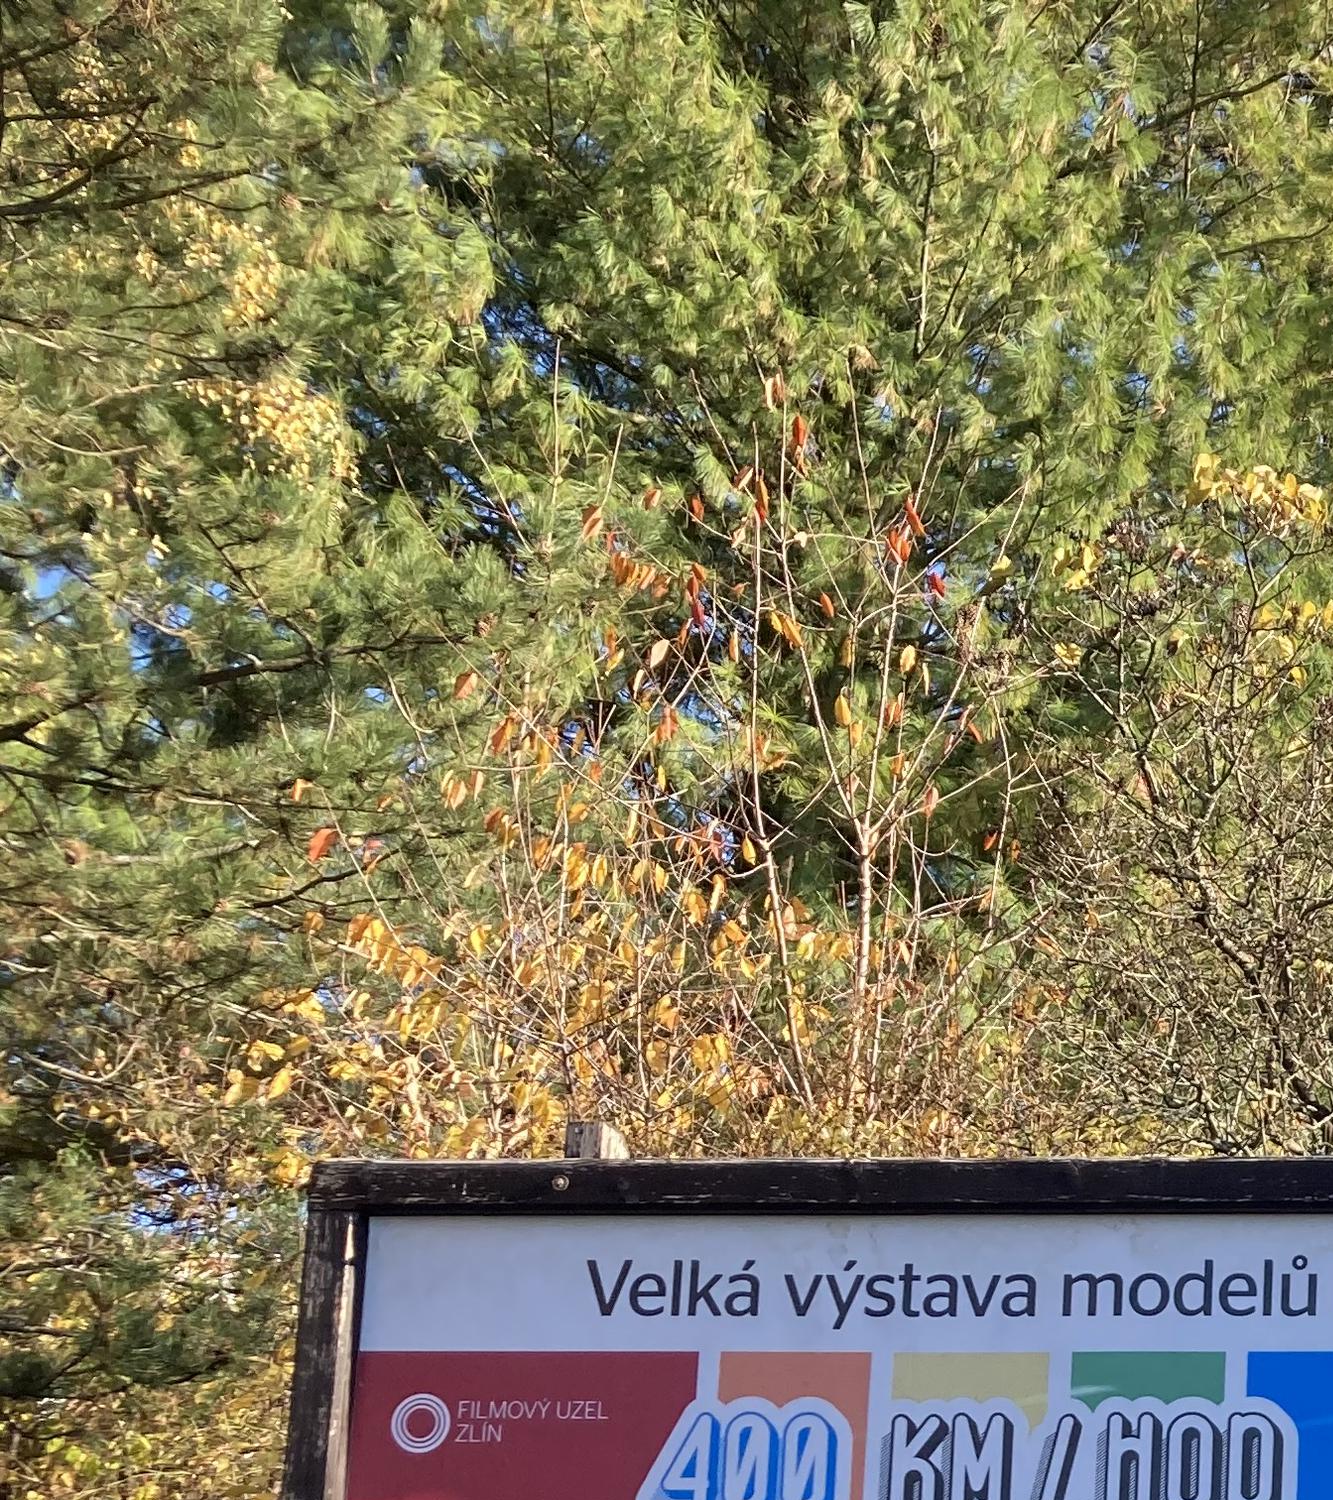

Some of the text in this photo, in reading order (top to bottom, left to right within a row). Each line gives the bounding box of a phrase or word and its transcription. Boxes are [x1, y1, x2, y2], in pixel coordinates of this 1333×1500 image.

[587, 1259, 760, 1317] Velká
[784, 1260, 1037, 1329] výstava
[1062, 1254, 1318, 1317] modelů
[457, 1398, 608, 1420] FILMOVÝ UZEL
[455, 1421, 502, 1443] ZLÍN
